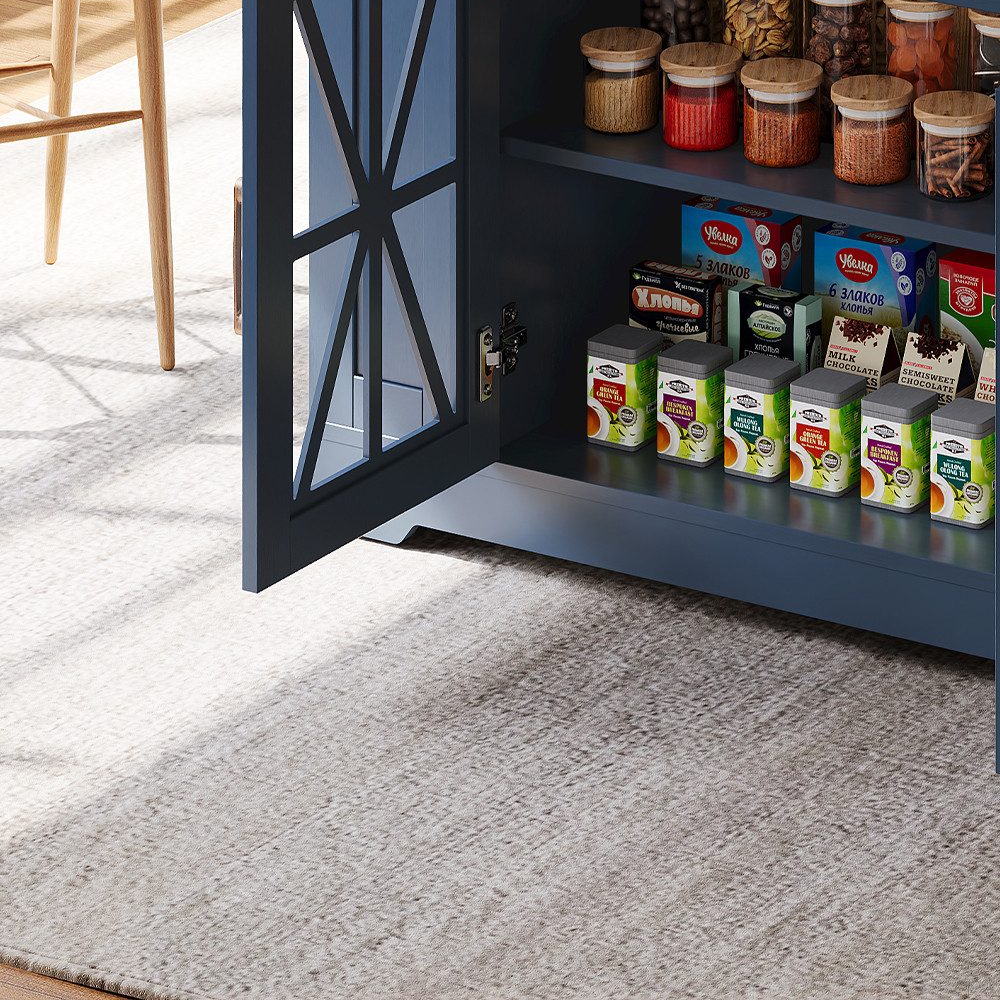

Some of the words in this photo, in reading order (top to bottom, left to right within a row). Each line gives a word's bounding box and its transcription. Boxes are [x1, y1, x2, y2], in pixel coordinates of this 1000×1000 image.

[829, 283, 838, 297] 6
[828, 350, 857, 363] MILK
[826, 359, 879, 377] CHOCOLATE
[902, 368, 956, 385] SEMISWEET
[901, 376, 954, 394] CHOCOLATE
